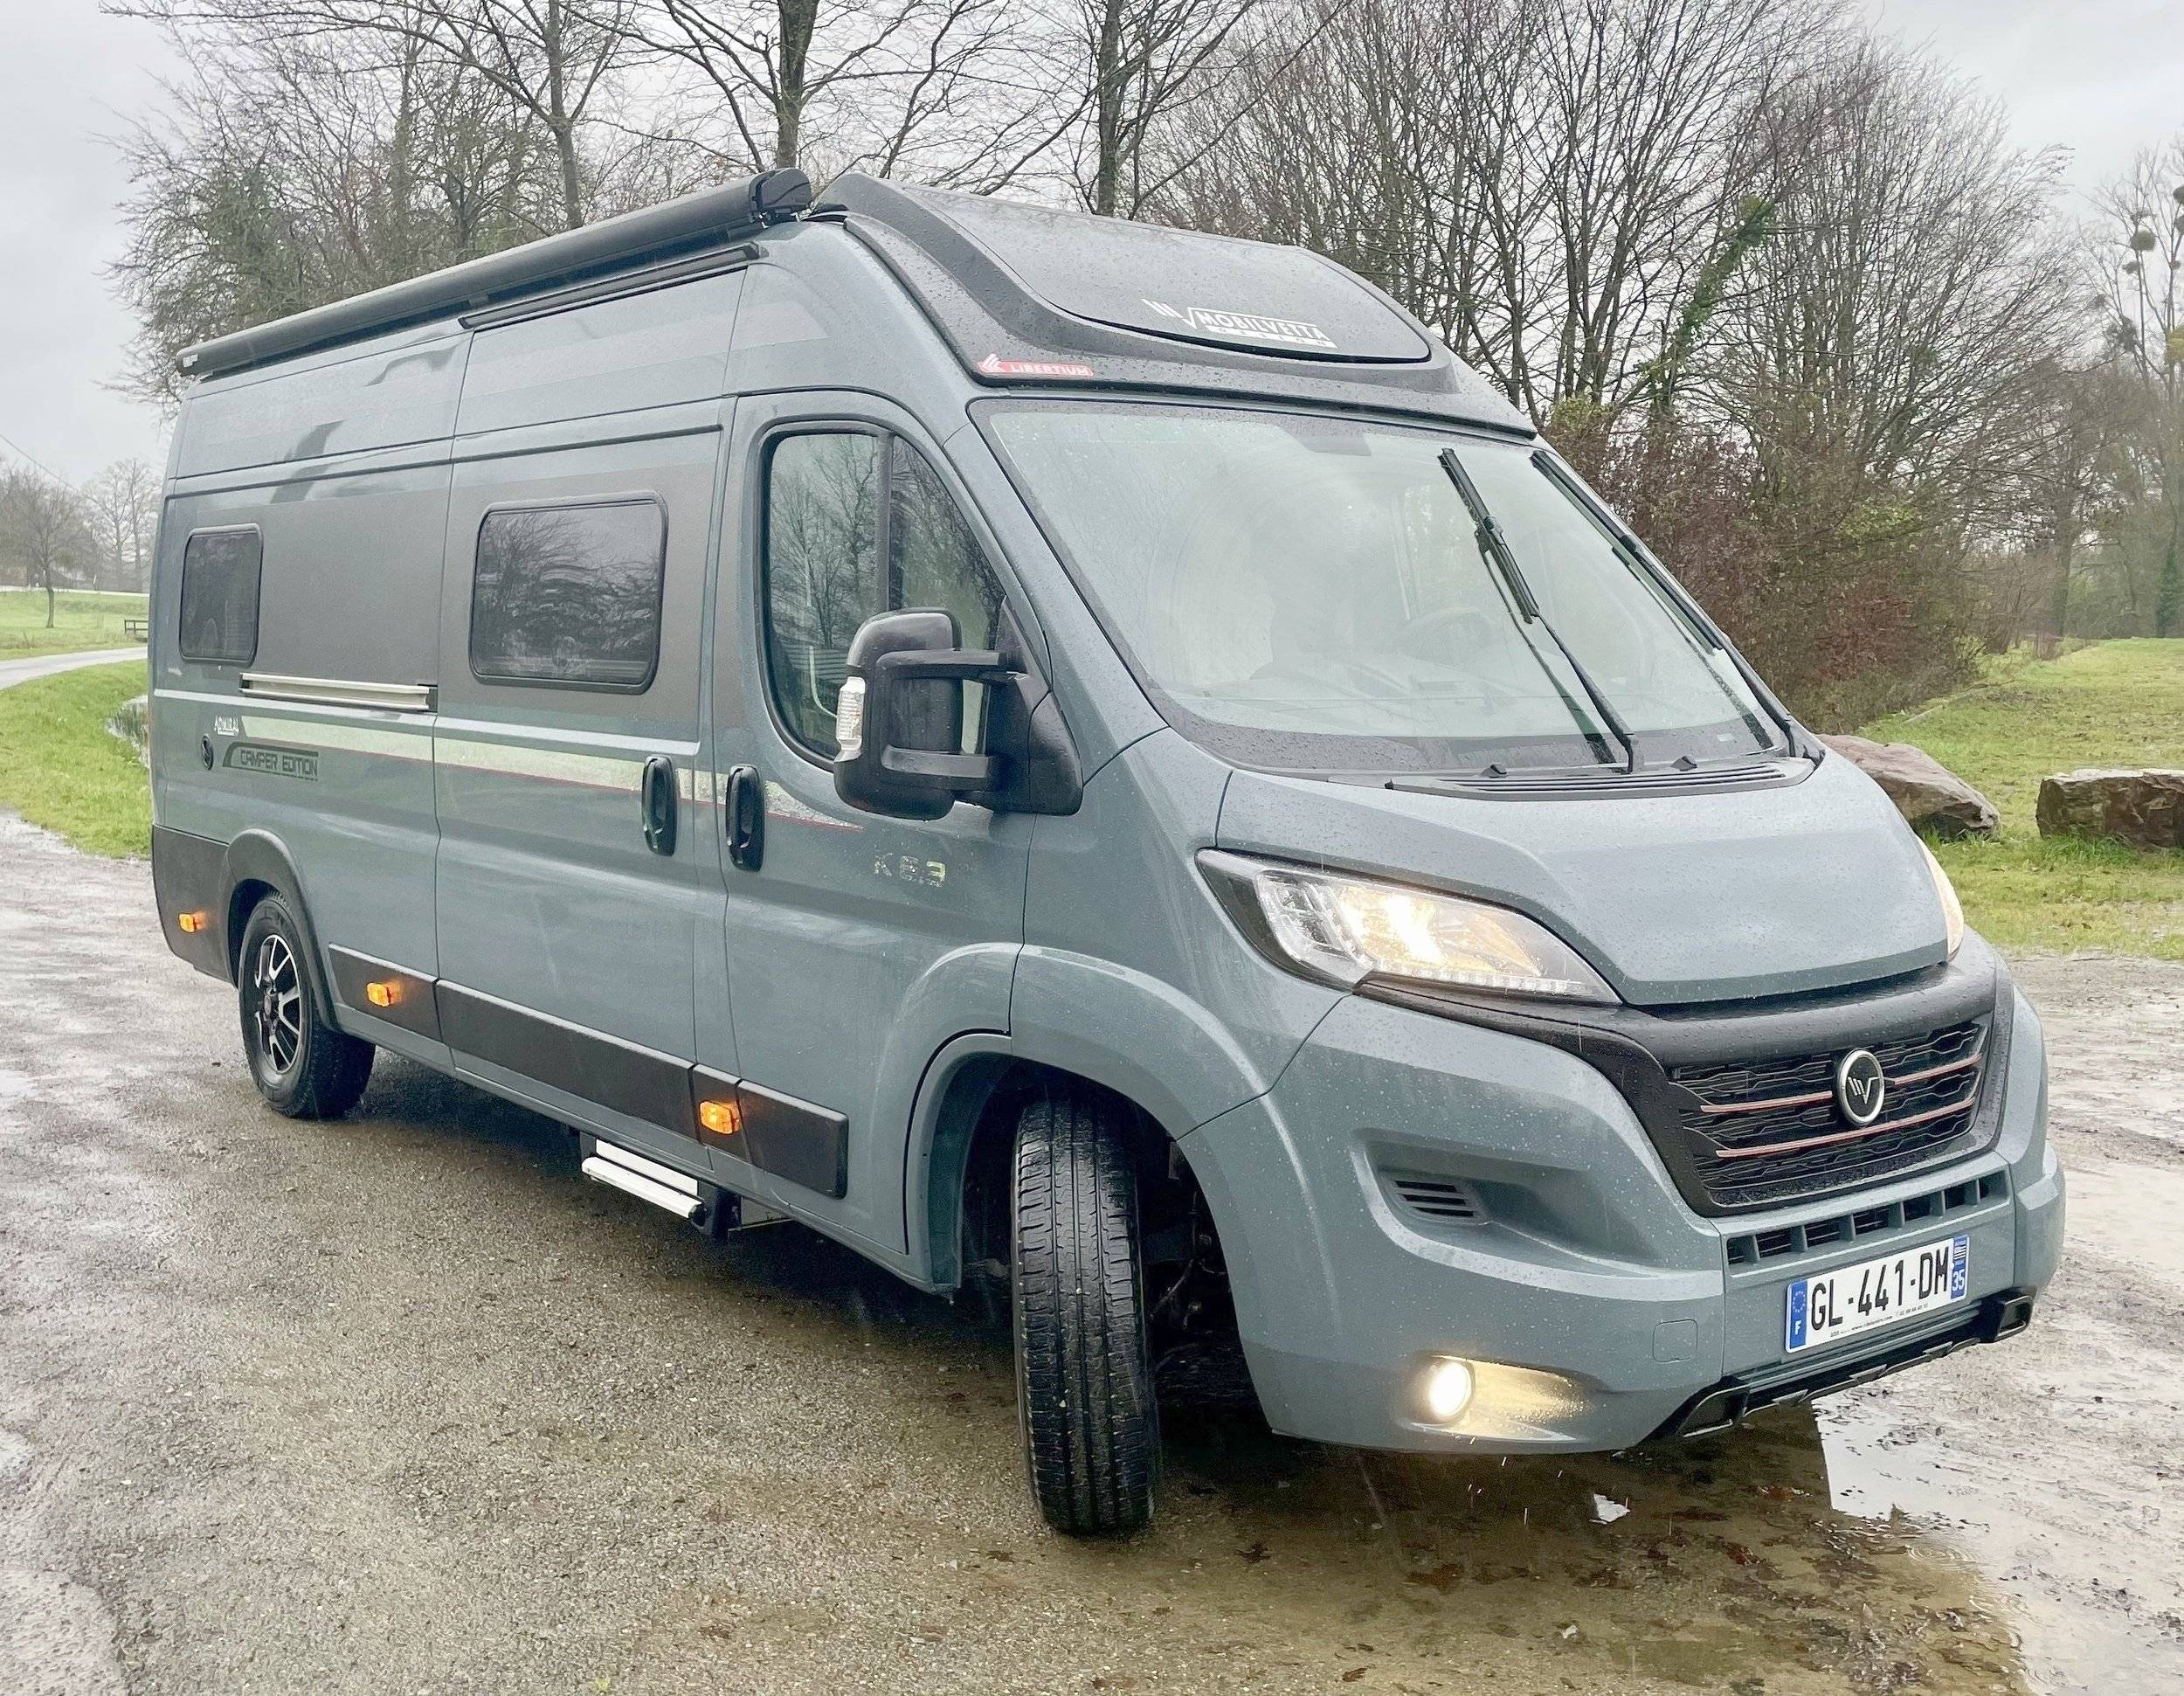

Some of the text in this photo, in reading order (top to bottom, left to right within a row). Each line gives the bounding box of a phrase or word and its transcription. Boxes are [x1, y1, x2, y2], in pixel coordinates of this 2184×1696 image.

[1195, 310, 1331, 341] MOBILVETTA
[1010, 362, 1094, 376] LIBERTIUM
[240, 750, 318, 776] CAMPER EDITION
[1810, 1246, 1950, 1331] GL-441-DM
[1952, 1268, 1965, 1291] 35
[1794, 1319, 1801, 1335] F
